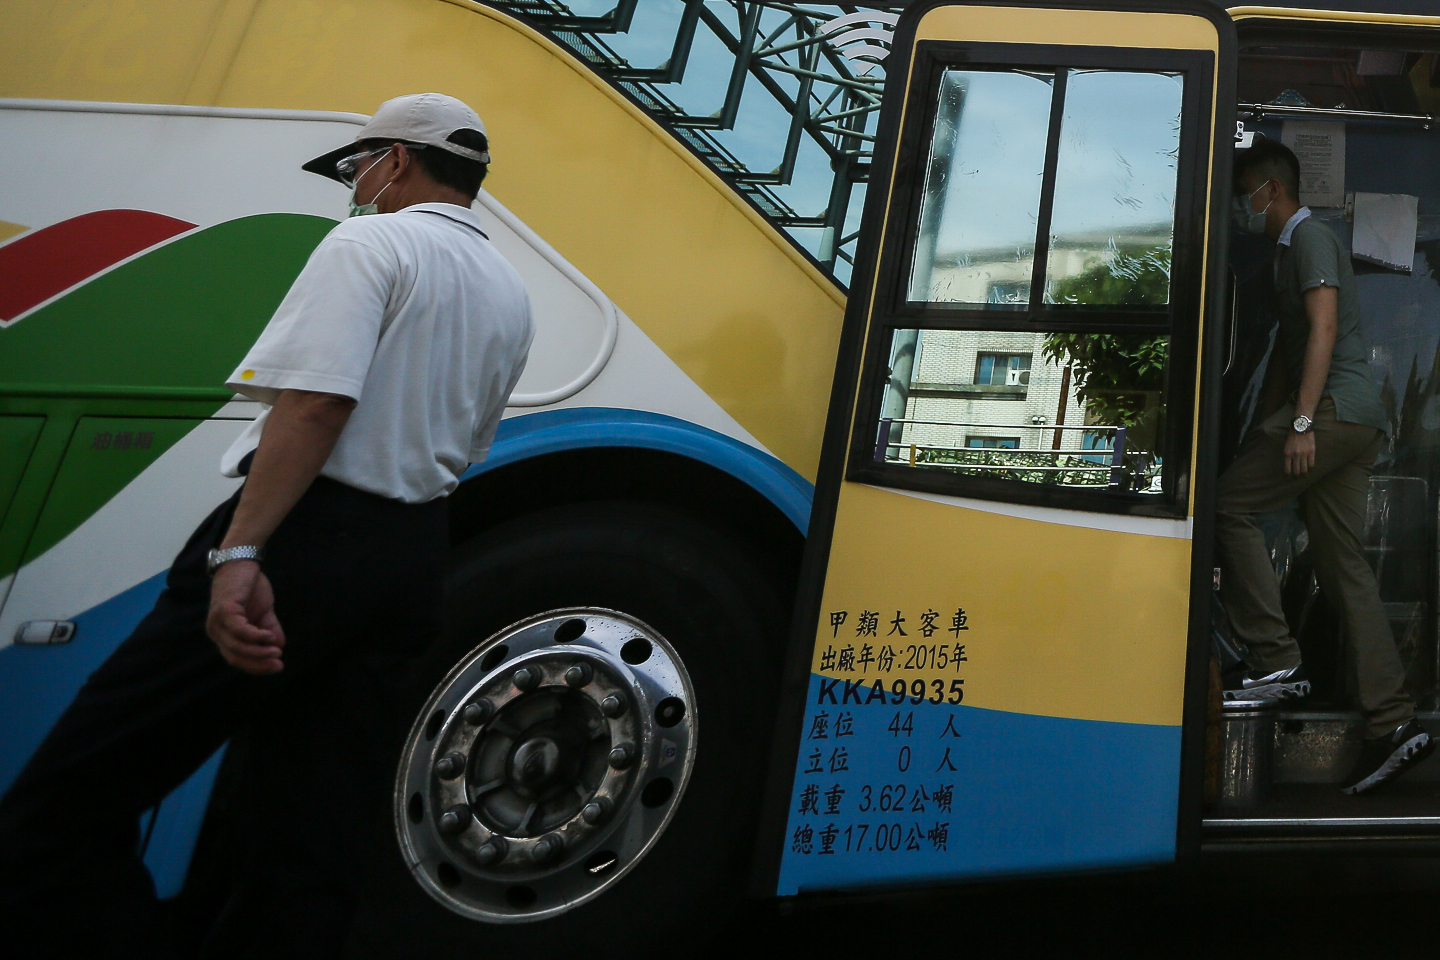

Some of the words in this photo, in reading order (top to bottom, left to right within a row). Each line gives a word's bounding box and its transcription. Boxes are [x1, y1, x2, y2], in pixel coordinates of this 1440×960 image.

[829, 608, 970, 639] 甲類大客車
[817, 678, 965, 706] KKA9935
[808, 710, 854, 740] 座位
[888, 711, 914, 737] 44
[939, 713, 962, 738] 人
[804, 746, 849, 774] 立位
[898, 745, 911, 773] 0
[935, 747, 958, 773] 人
[797, 783, 846, 816] 載重
